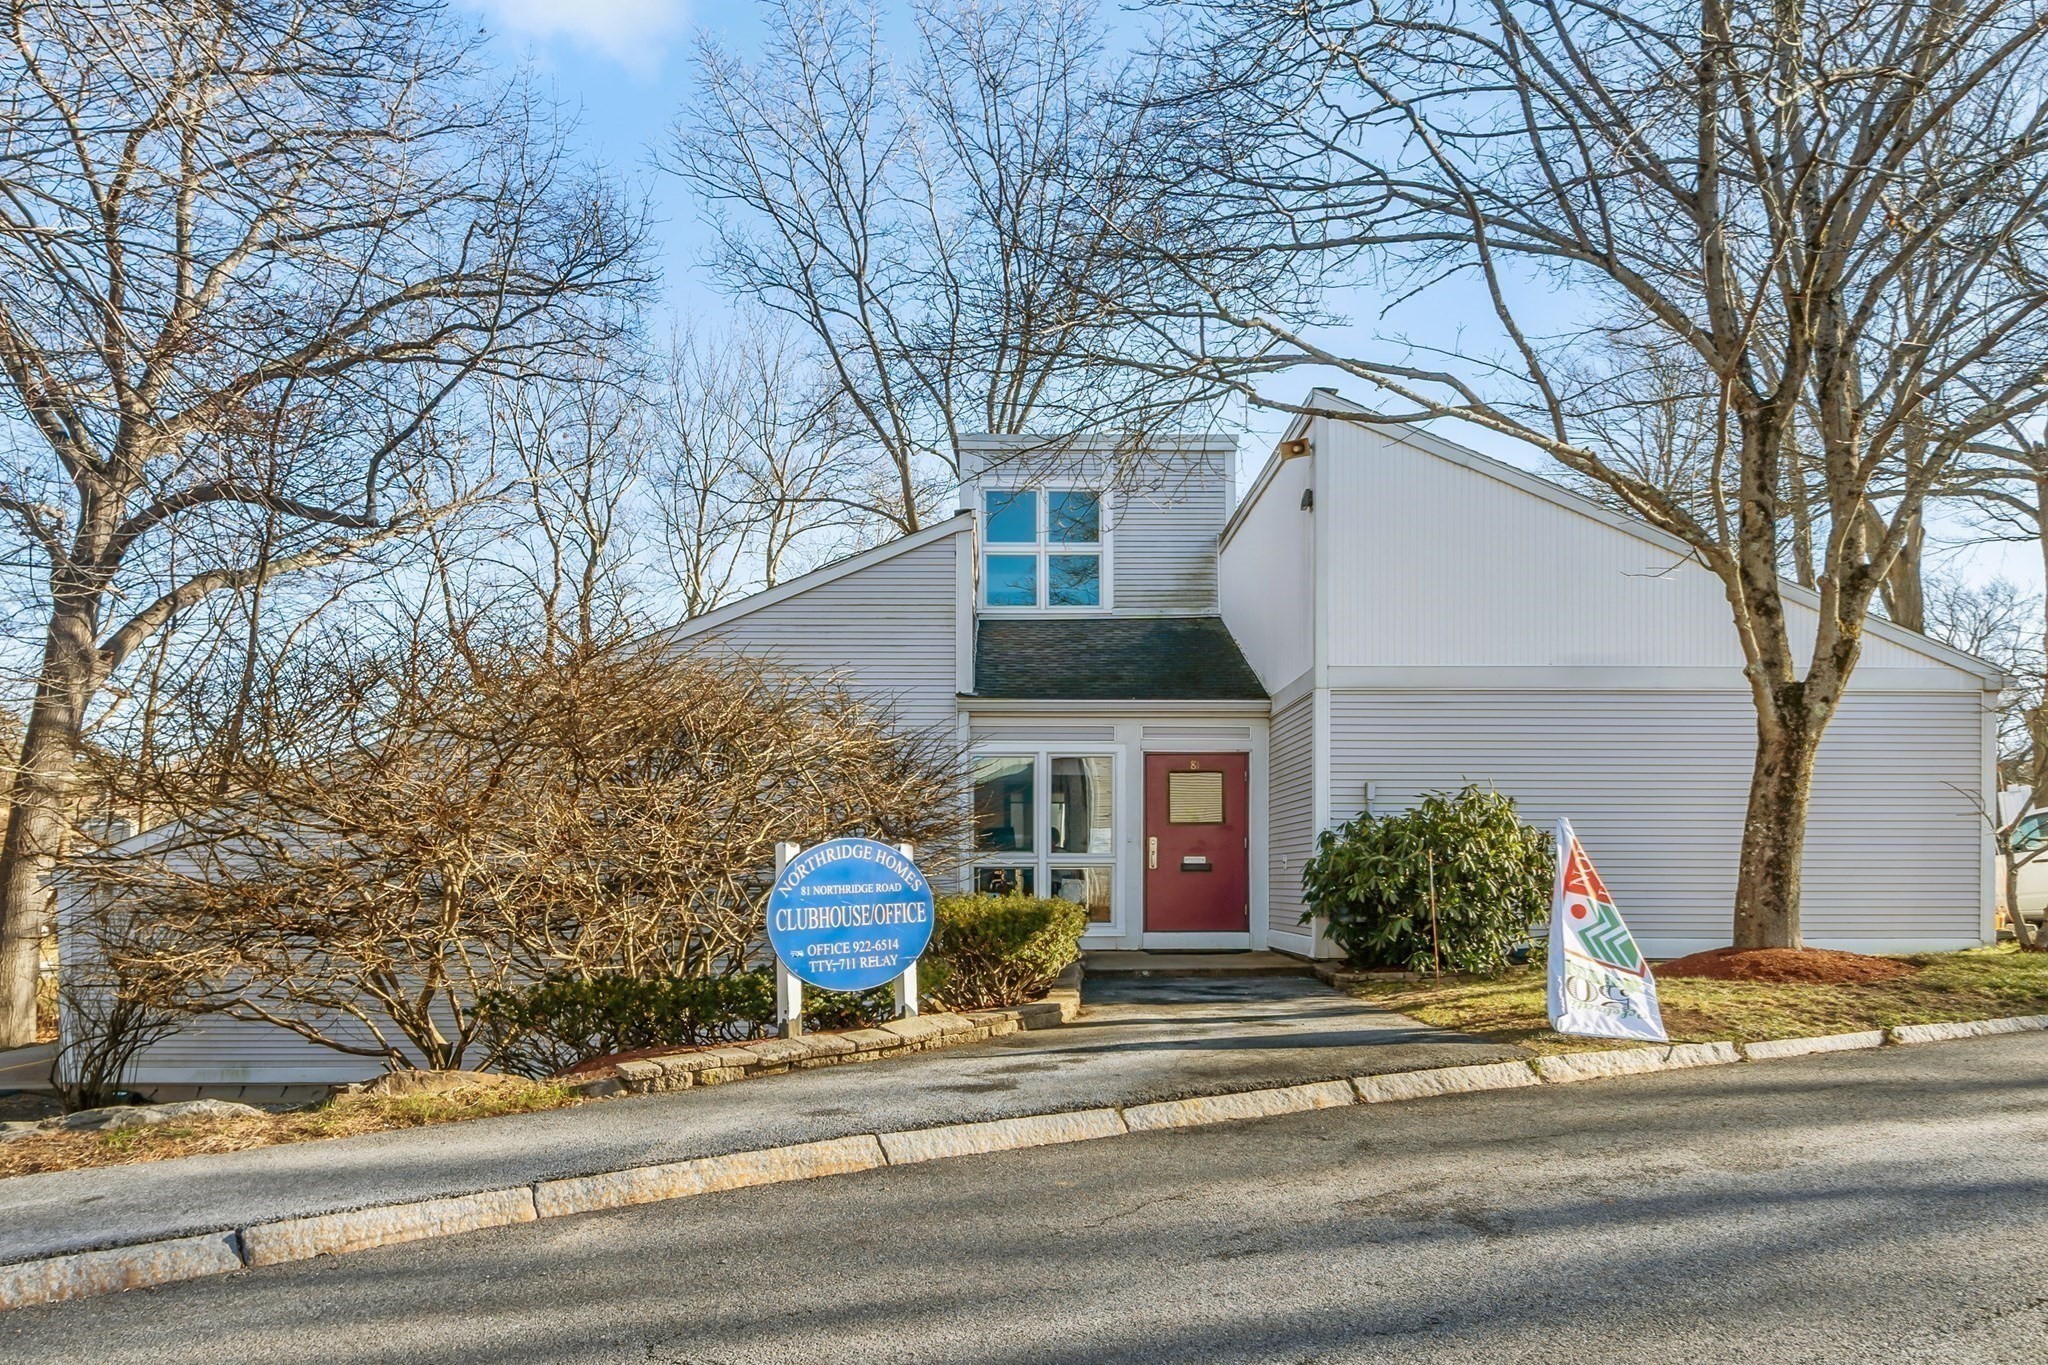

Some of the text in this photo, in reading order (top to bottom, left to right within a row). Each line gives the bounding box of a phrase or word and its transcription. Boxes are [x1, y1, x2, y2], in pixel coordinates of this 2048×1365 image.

[778, 844, 923, 898] NORTHRIDGE HOMES
[801, 882, 902, 896] 81 NORTHRIDGE ROAD
[775, 902, 927, 932] CLUBHOUSE/OFFICE
[807, 939, 899, 956] OFFICE 922-6514
[860, 954, 898, 968] RELAY
